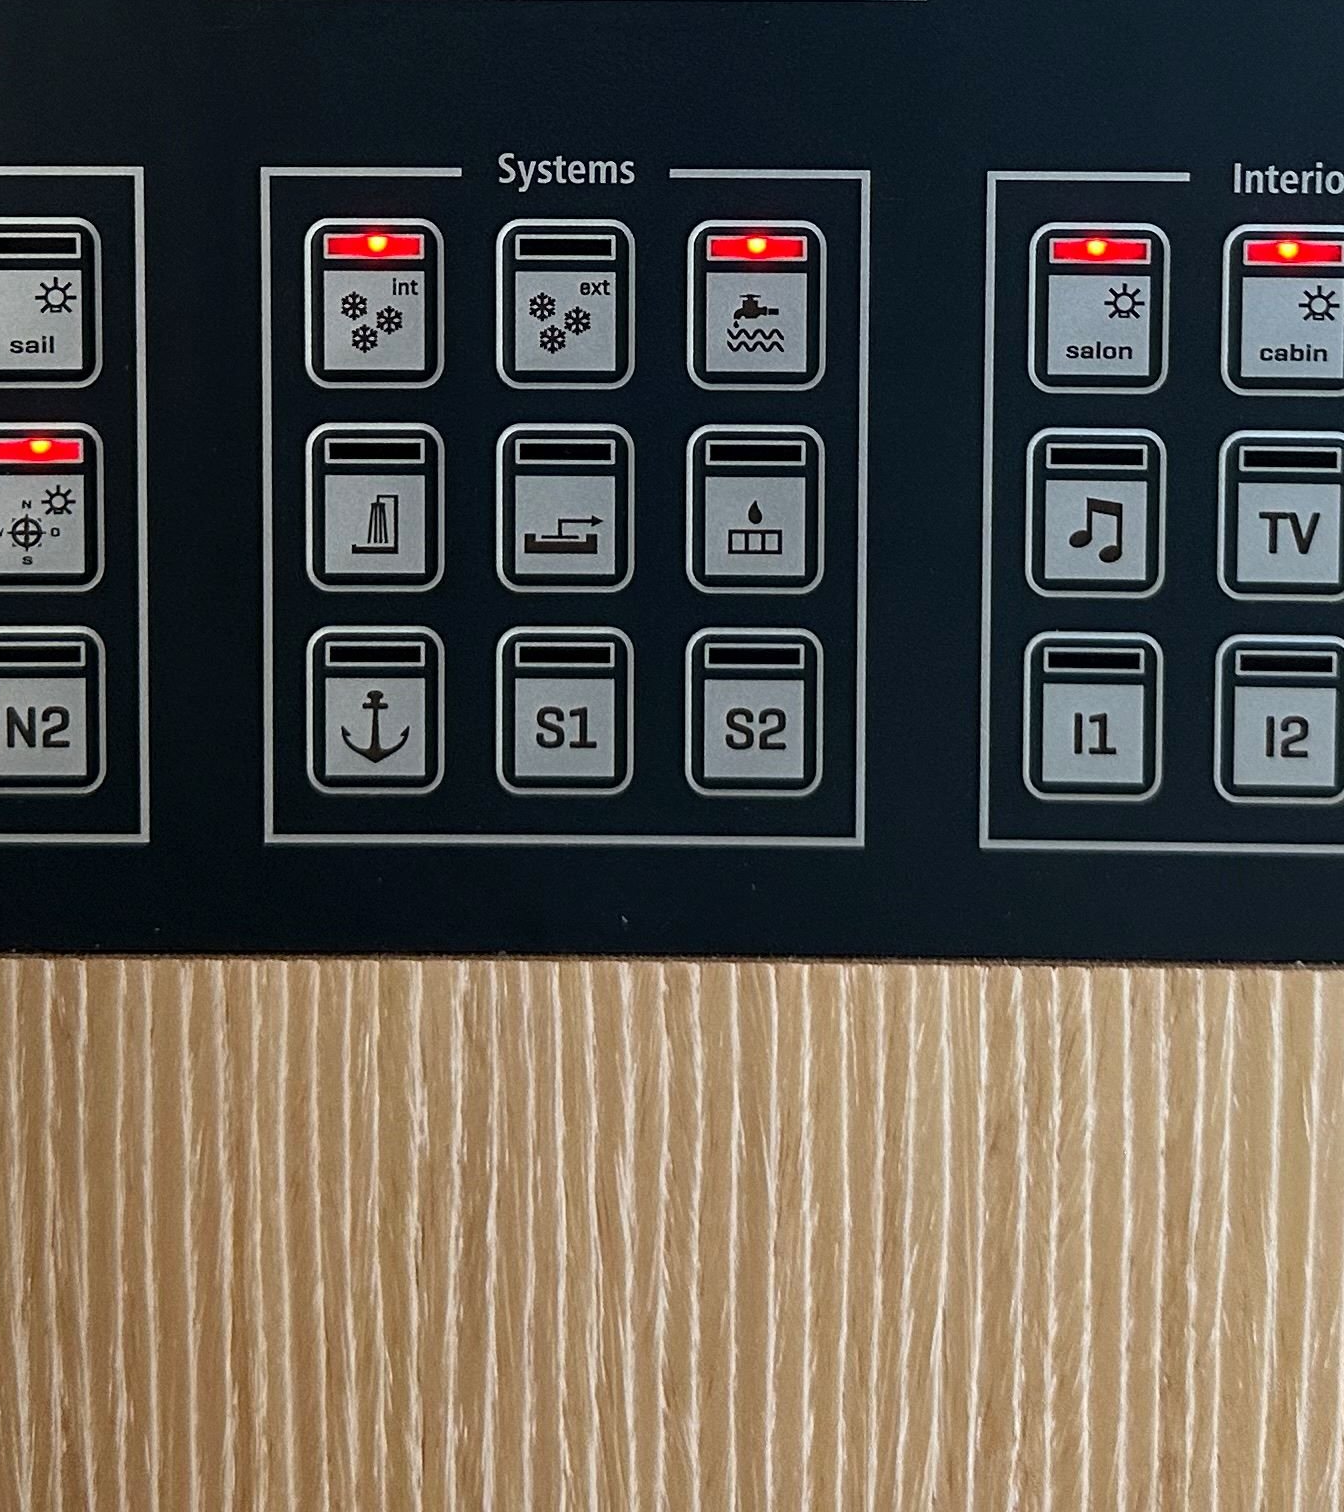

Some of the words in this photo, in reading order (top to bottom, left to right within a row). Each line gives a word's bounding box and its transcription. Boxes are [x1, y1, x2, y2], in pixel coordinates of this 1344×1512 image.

[498, 152, 636, 193] Systems
[392, 278, 419, 296] int
[580, 279, 611, 296] ext
[9, 334, 55, 355] sail
[1065, 340, 1133, 361] salon
[1259, 343, 1328, 364] cabin
[21, 499, 32, 509] N
[1258, 511, 1321, 554] TV
[22, 555, 33, 566] S
[5, 706, 71, 749] N2
[535, 706, 597, 749] S1
[725, 707, 787, 750] S2
[1265, 715, 1309, 758] I2
